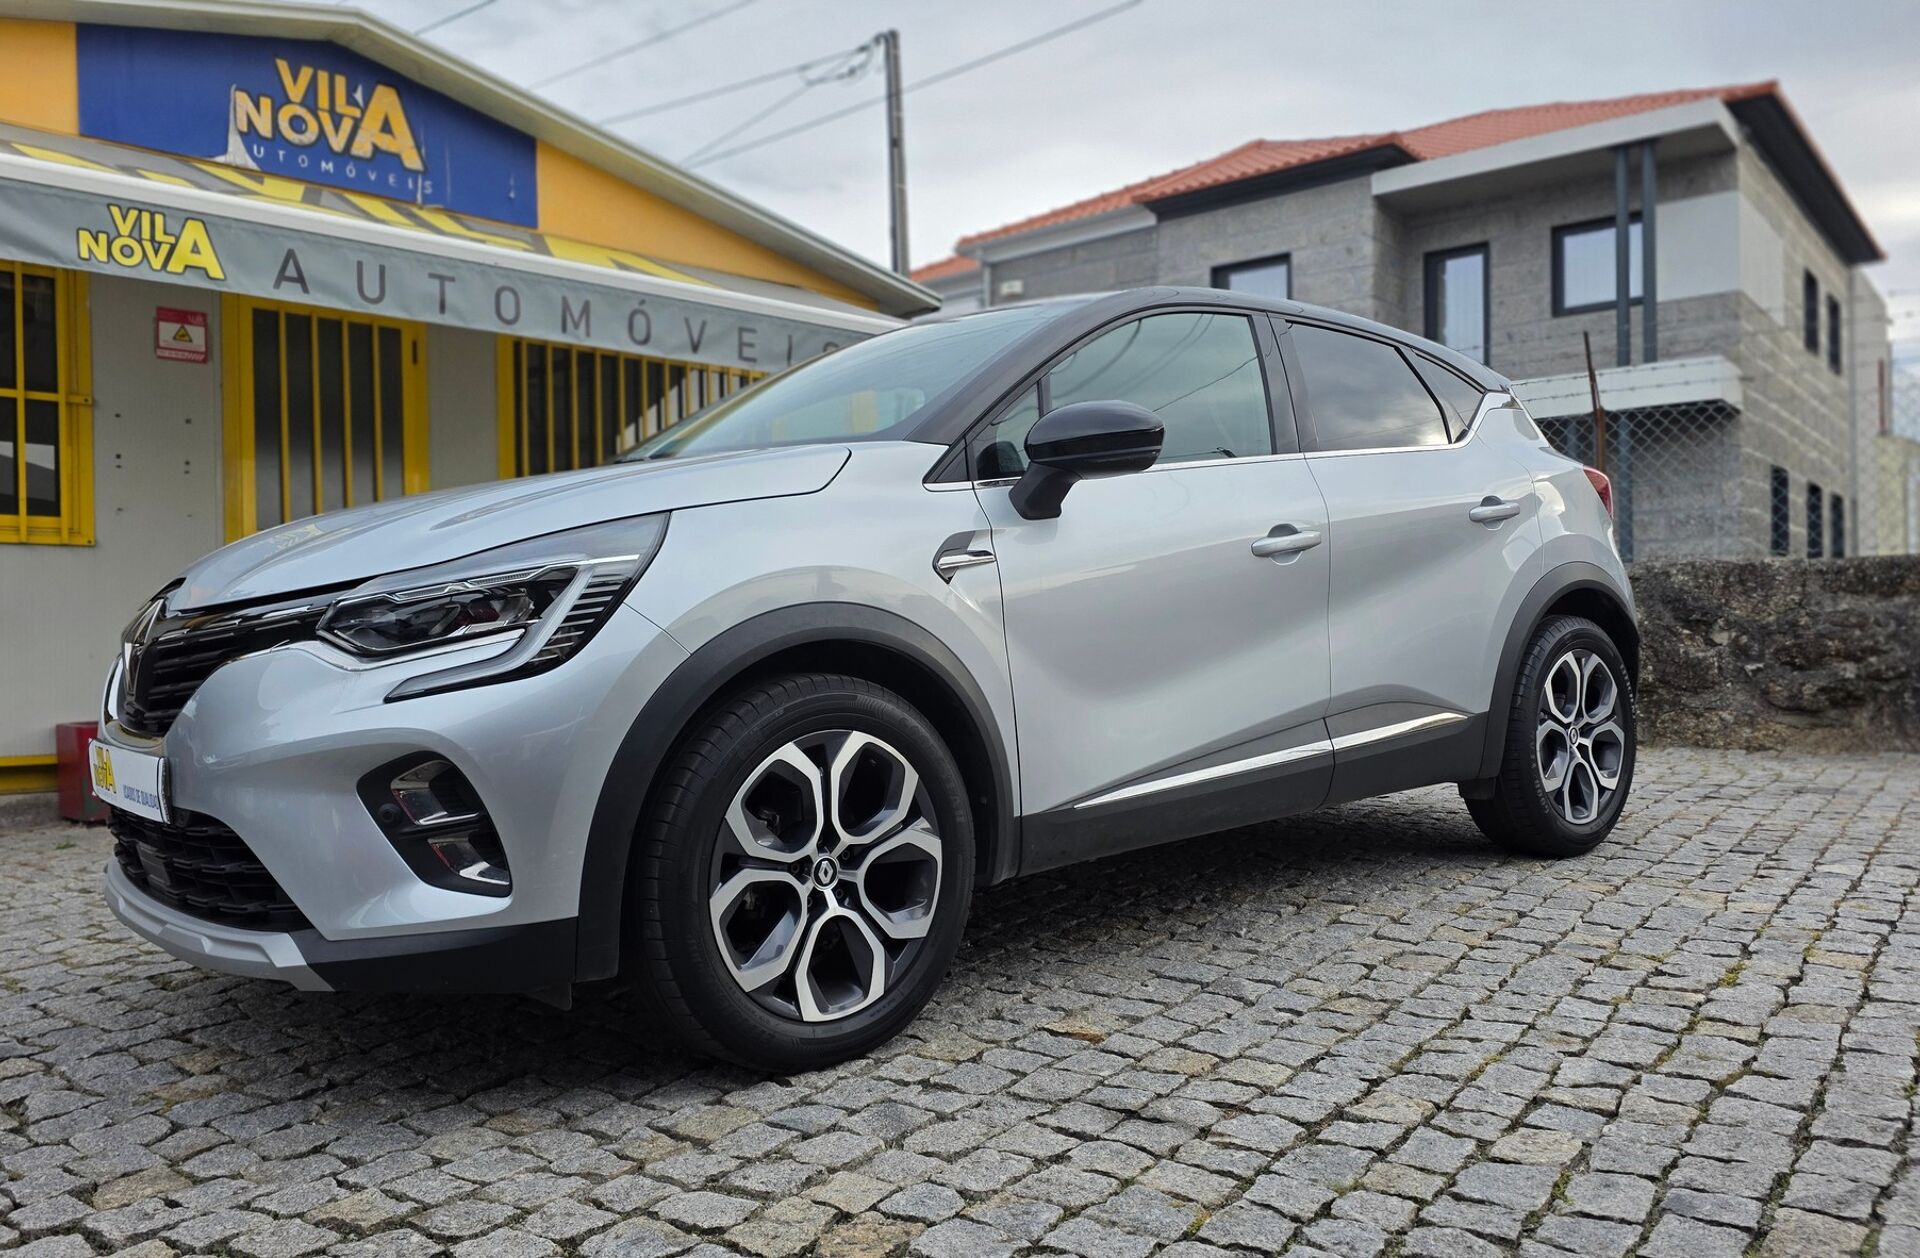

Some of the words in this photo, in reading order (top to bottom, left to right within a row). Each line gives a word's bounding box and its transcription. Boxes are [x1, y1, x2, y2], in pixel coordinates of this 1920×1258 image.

[234, 88, 425, 172] NOVA
[252, 145, 433, 195] UTOMÓVEIS
[77, 227, 226, 281] NOVA
